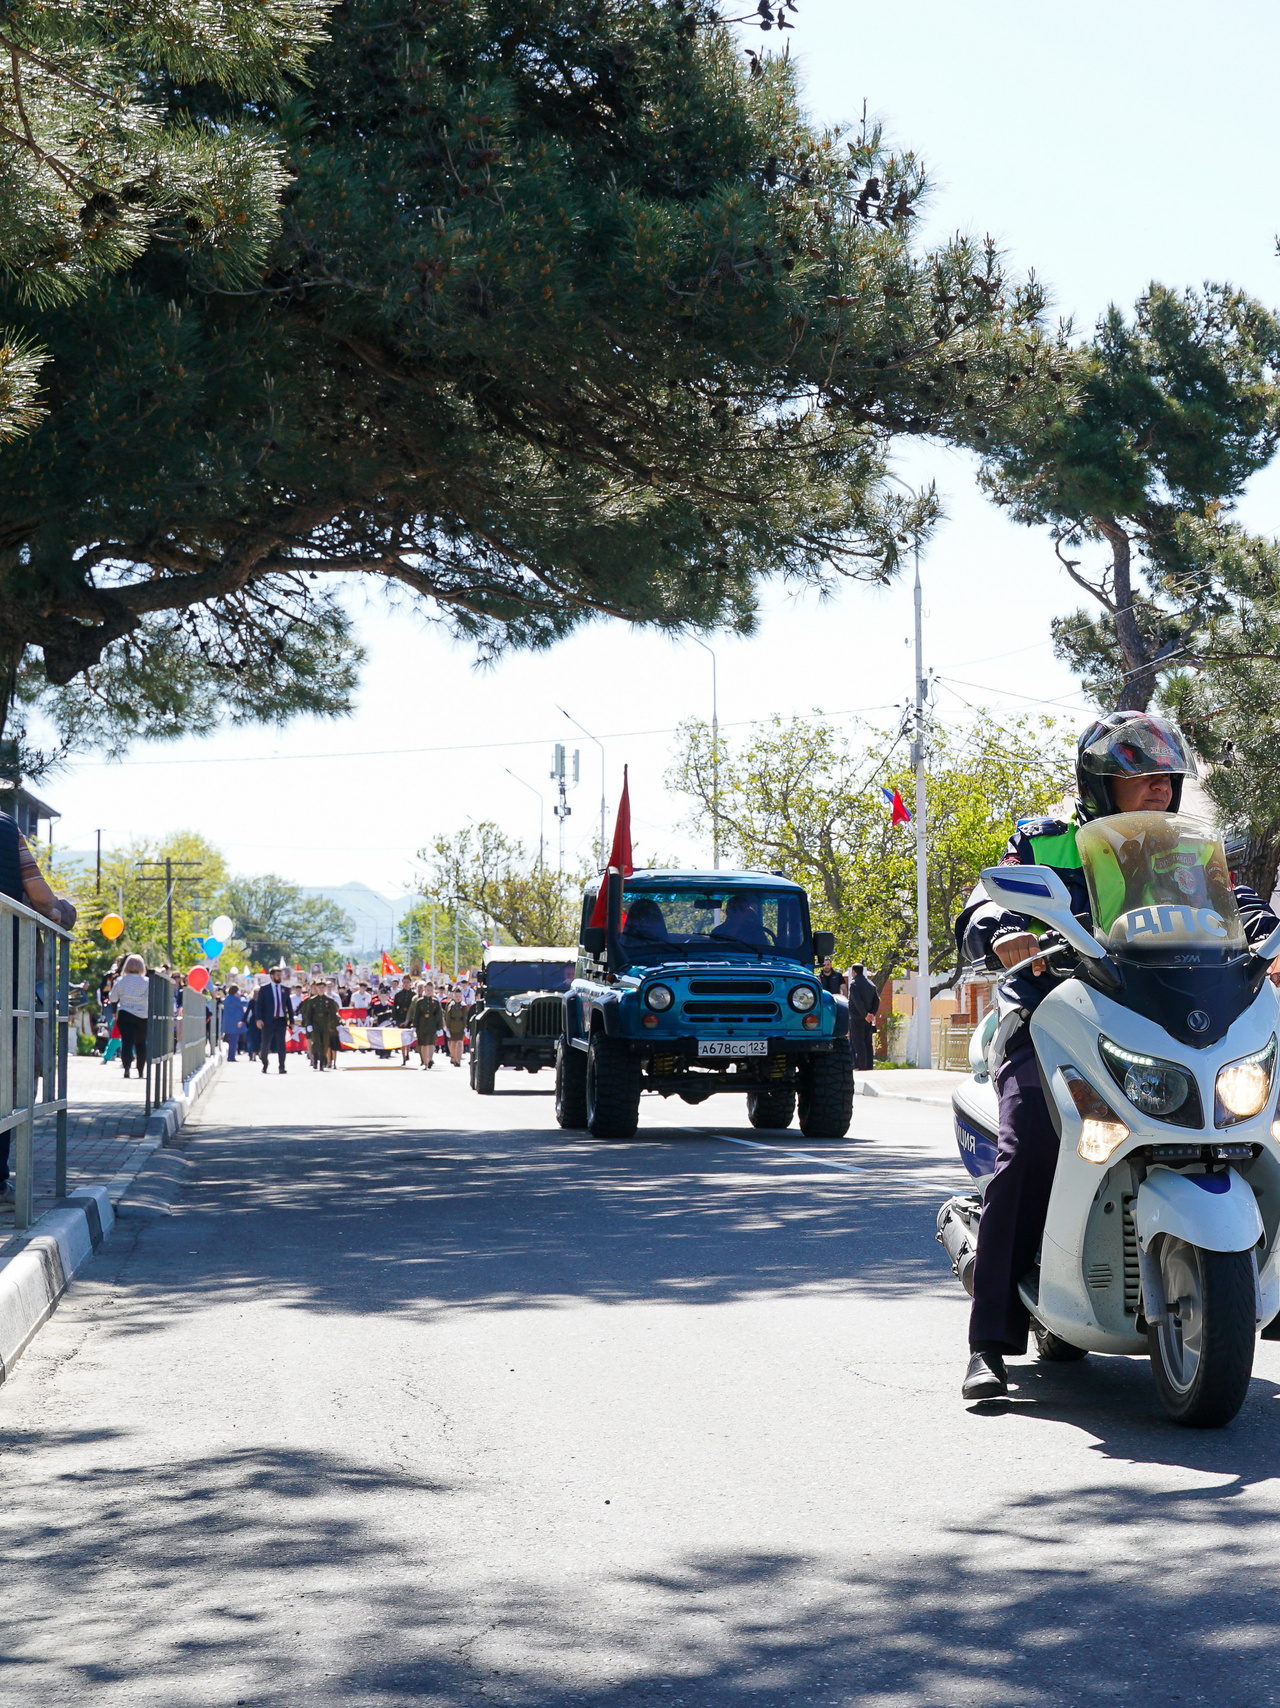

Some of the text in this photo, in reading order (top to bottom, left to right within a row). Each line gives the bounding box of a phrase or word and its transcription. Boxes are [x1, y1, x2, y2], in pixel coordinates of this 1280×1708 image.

[1125, 905, 1227, 943] ДПС
[1173, 954, 1201, 964] SYM
[701, 1042, 765, 1055] А678СС 123
